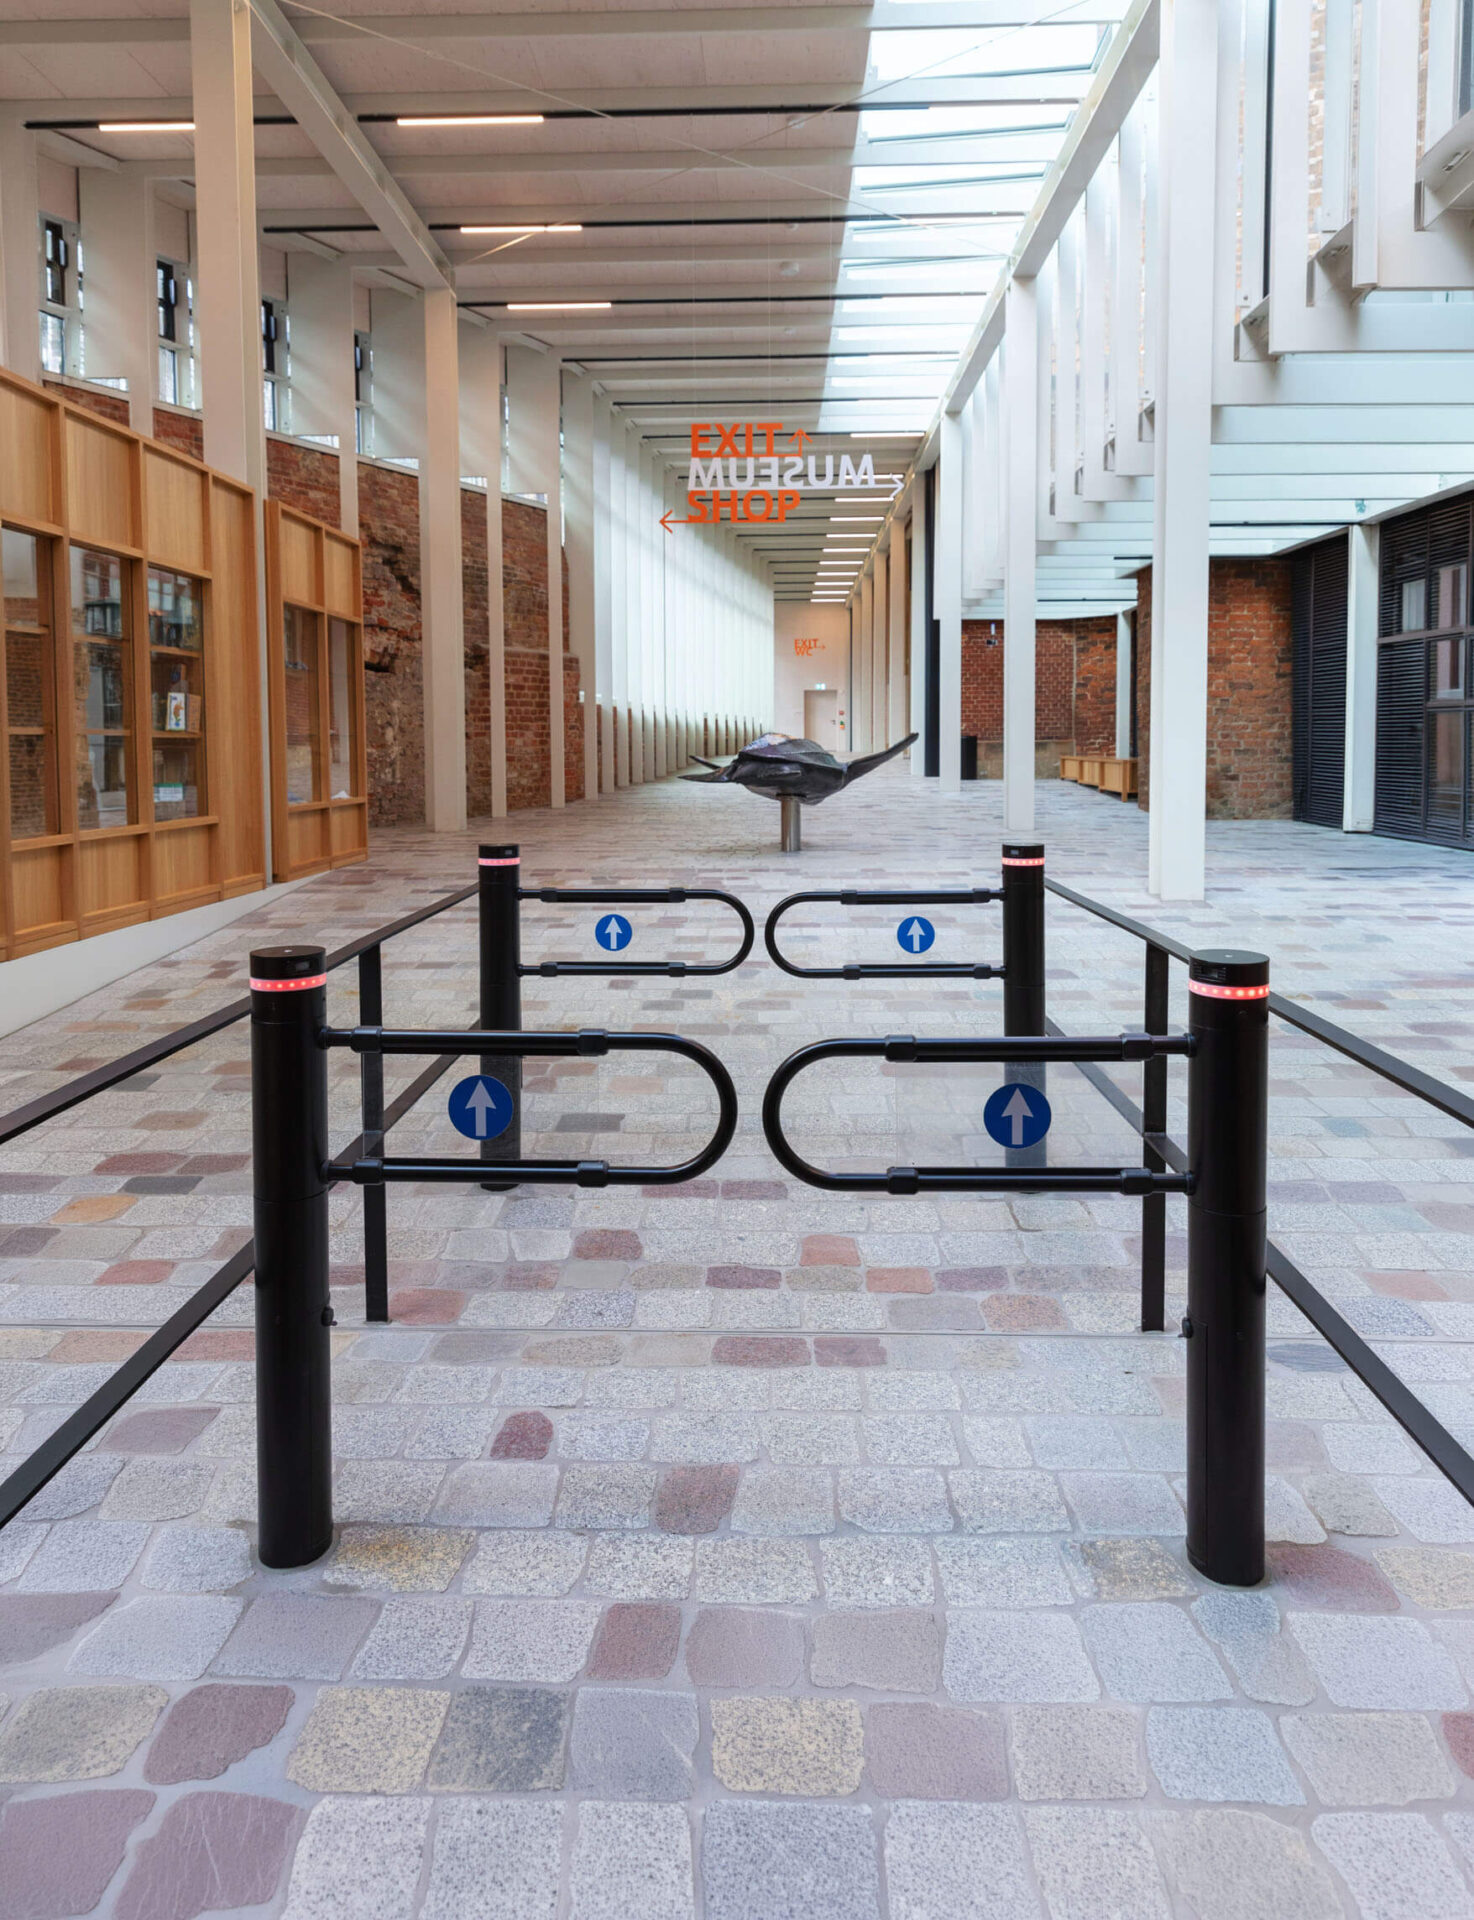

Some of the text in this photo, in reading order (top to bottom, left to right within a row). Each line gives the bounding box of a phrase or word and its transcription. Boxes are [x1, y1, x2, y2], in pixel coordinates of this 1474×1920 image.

[690, 423, 783, 458] EXIT
[687, 489, 801, 523] SHOP
[794, 638, 819, 649] EXIT
[794, 647, 813, 657] WC
